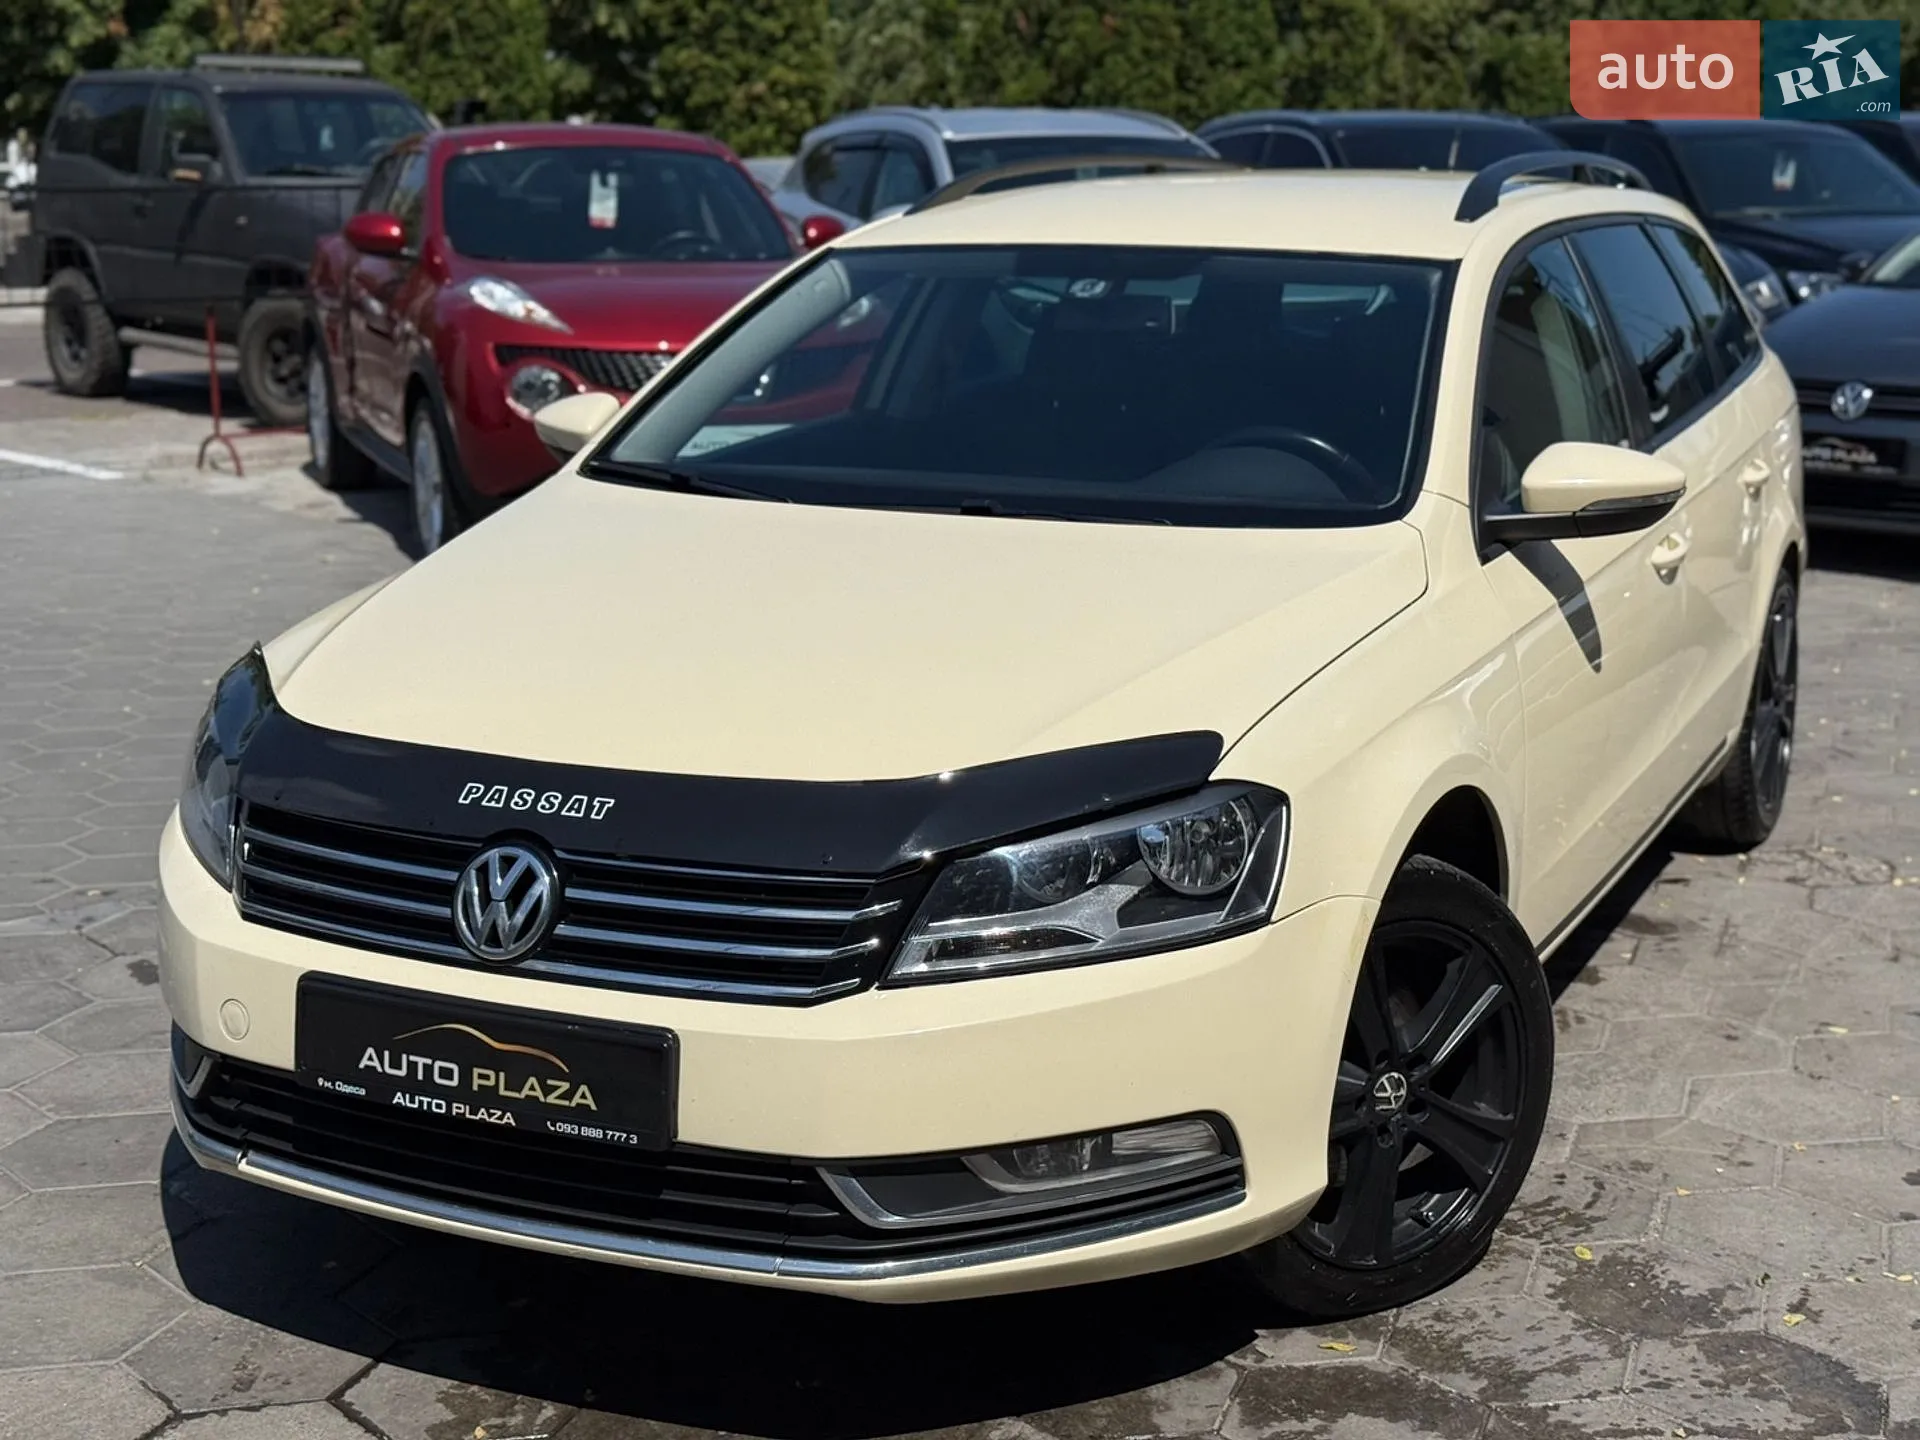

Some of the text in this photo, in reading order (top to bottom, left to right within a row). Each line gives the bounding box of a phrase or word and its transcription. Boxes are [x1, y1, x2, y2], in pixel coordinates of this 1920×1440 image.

[458, 782, 615, 820] PASSAT
[358, 1046, 598, 1111] AUTO PLAZA
[392, 1092, 516, 1127] AUTO PLAZA
[556, 1122, 638, 1144] 093 888 777 3
